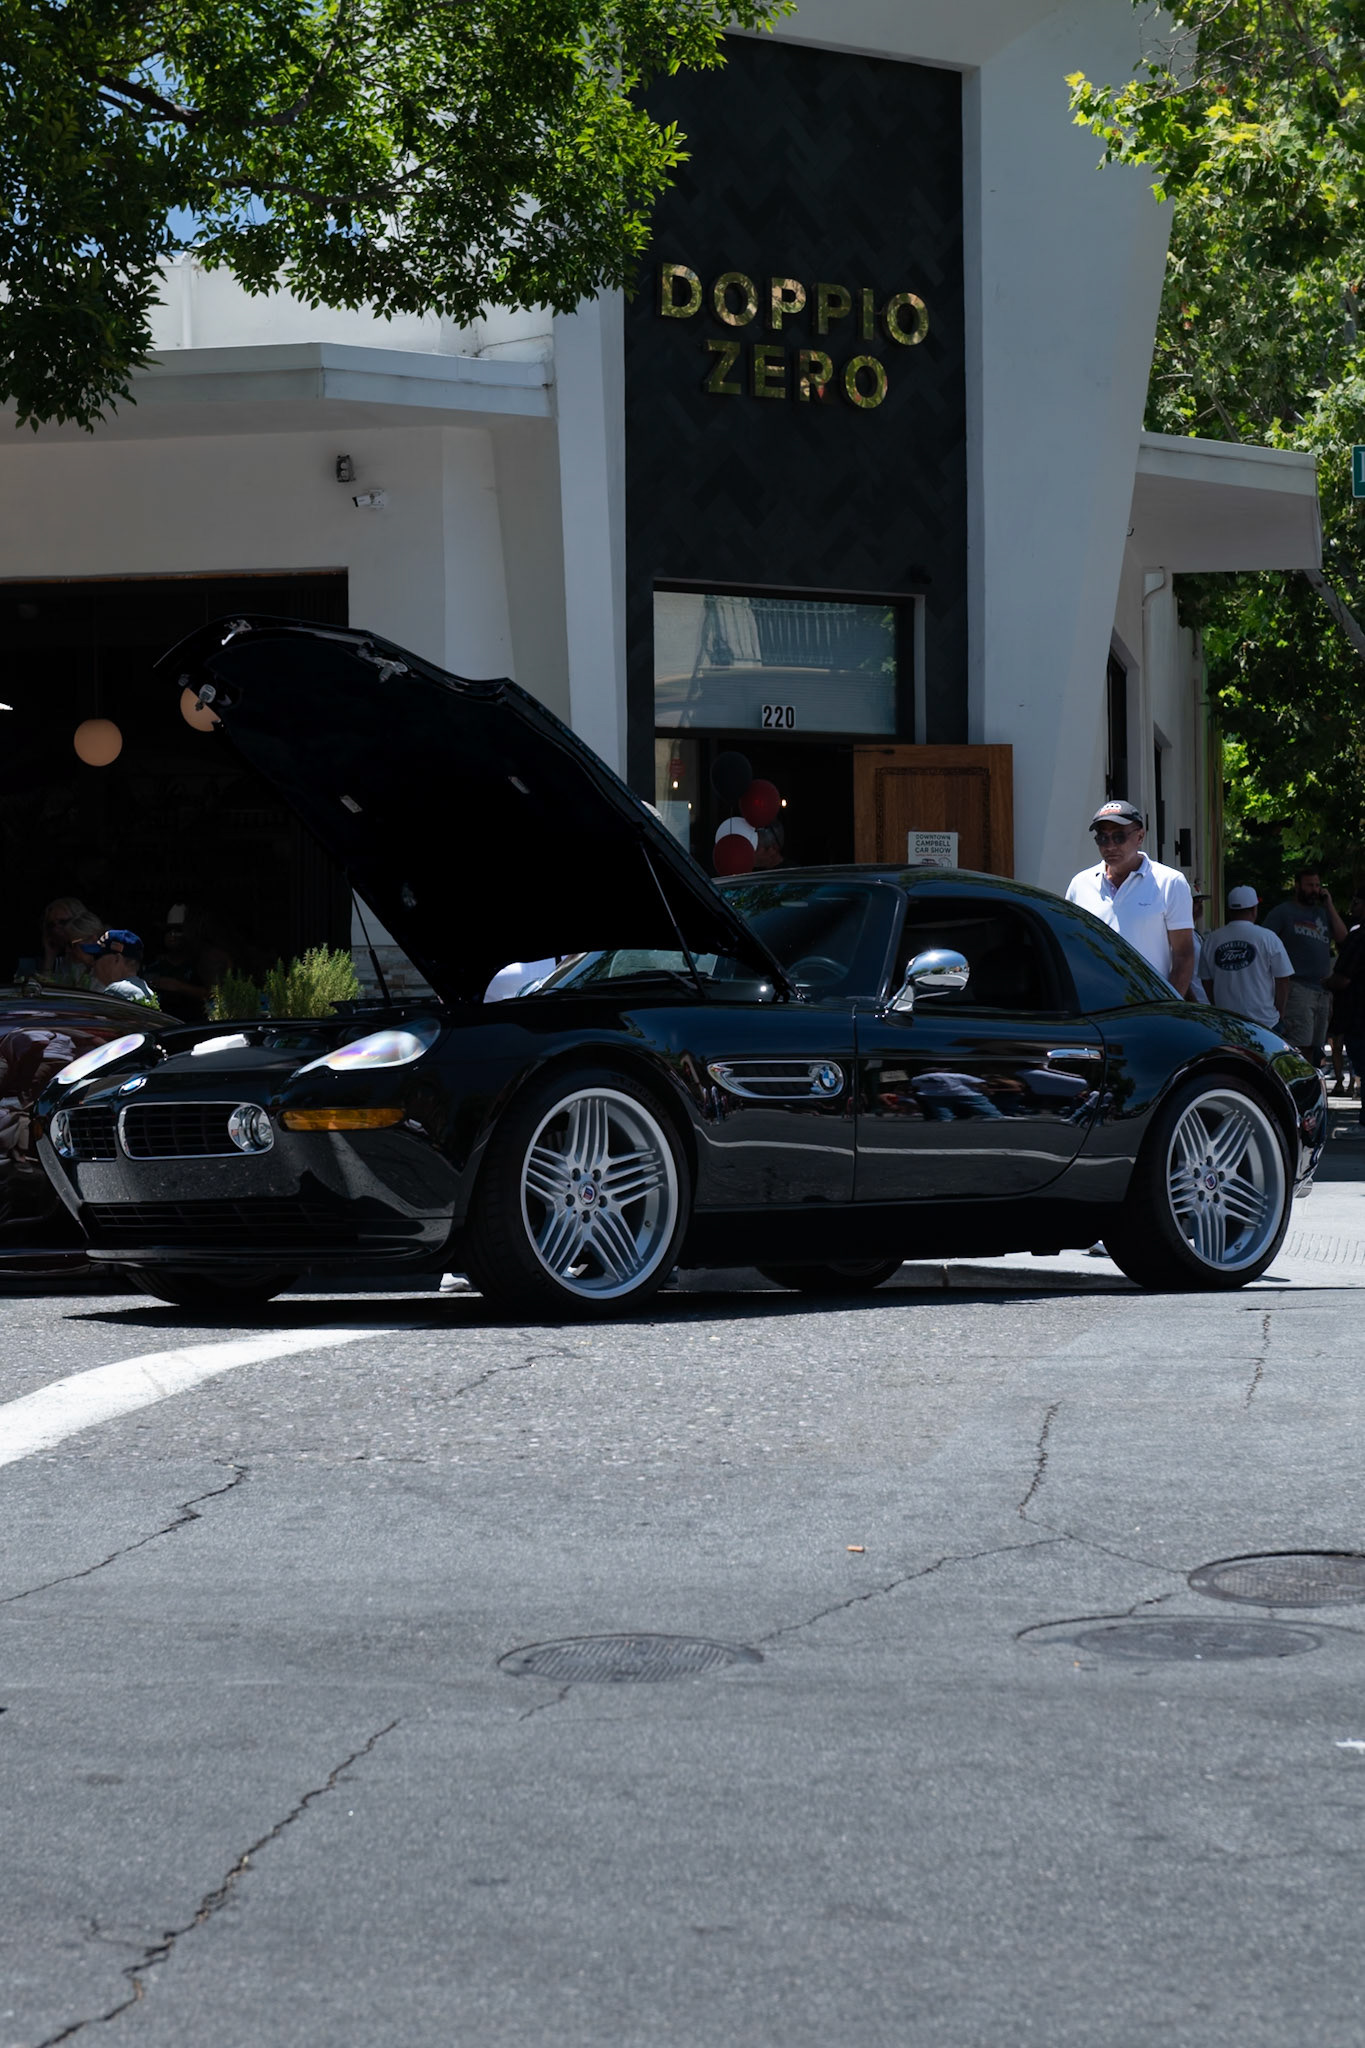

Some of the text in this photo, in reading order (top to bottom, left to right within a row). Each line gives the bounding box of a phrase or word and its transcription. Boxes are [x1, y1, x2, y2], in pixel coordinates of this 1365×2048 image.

[661, 262, 929, 345] DOPPIO
[705, 339, 889, 409] ZERO
[763, 705, 795, 729] 220
[1221, 950, 1248, 961] Ford
